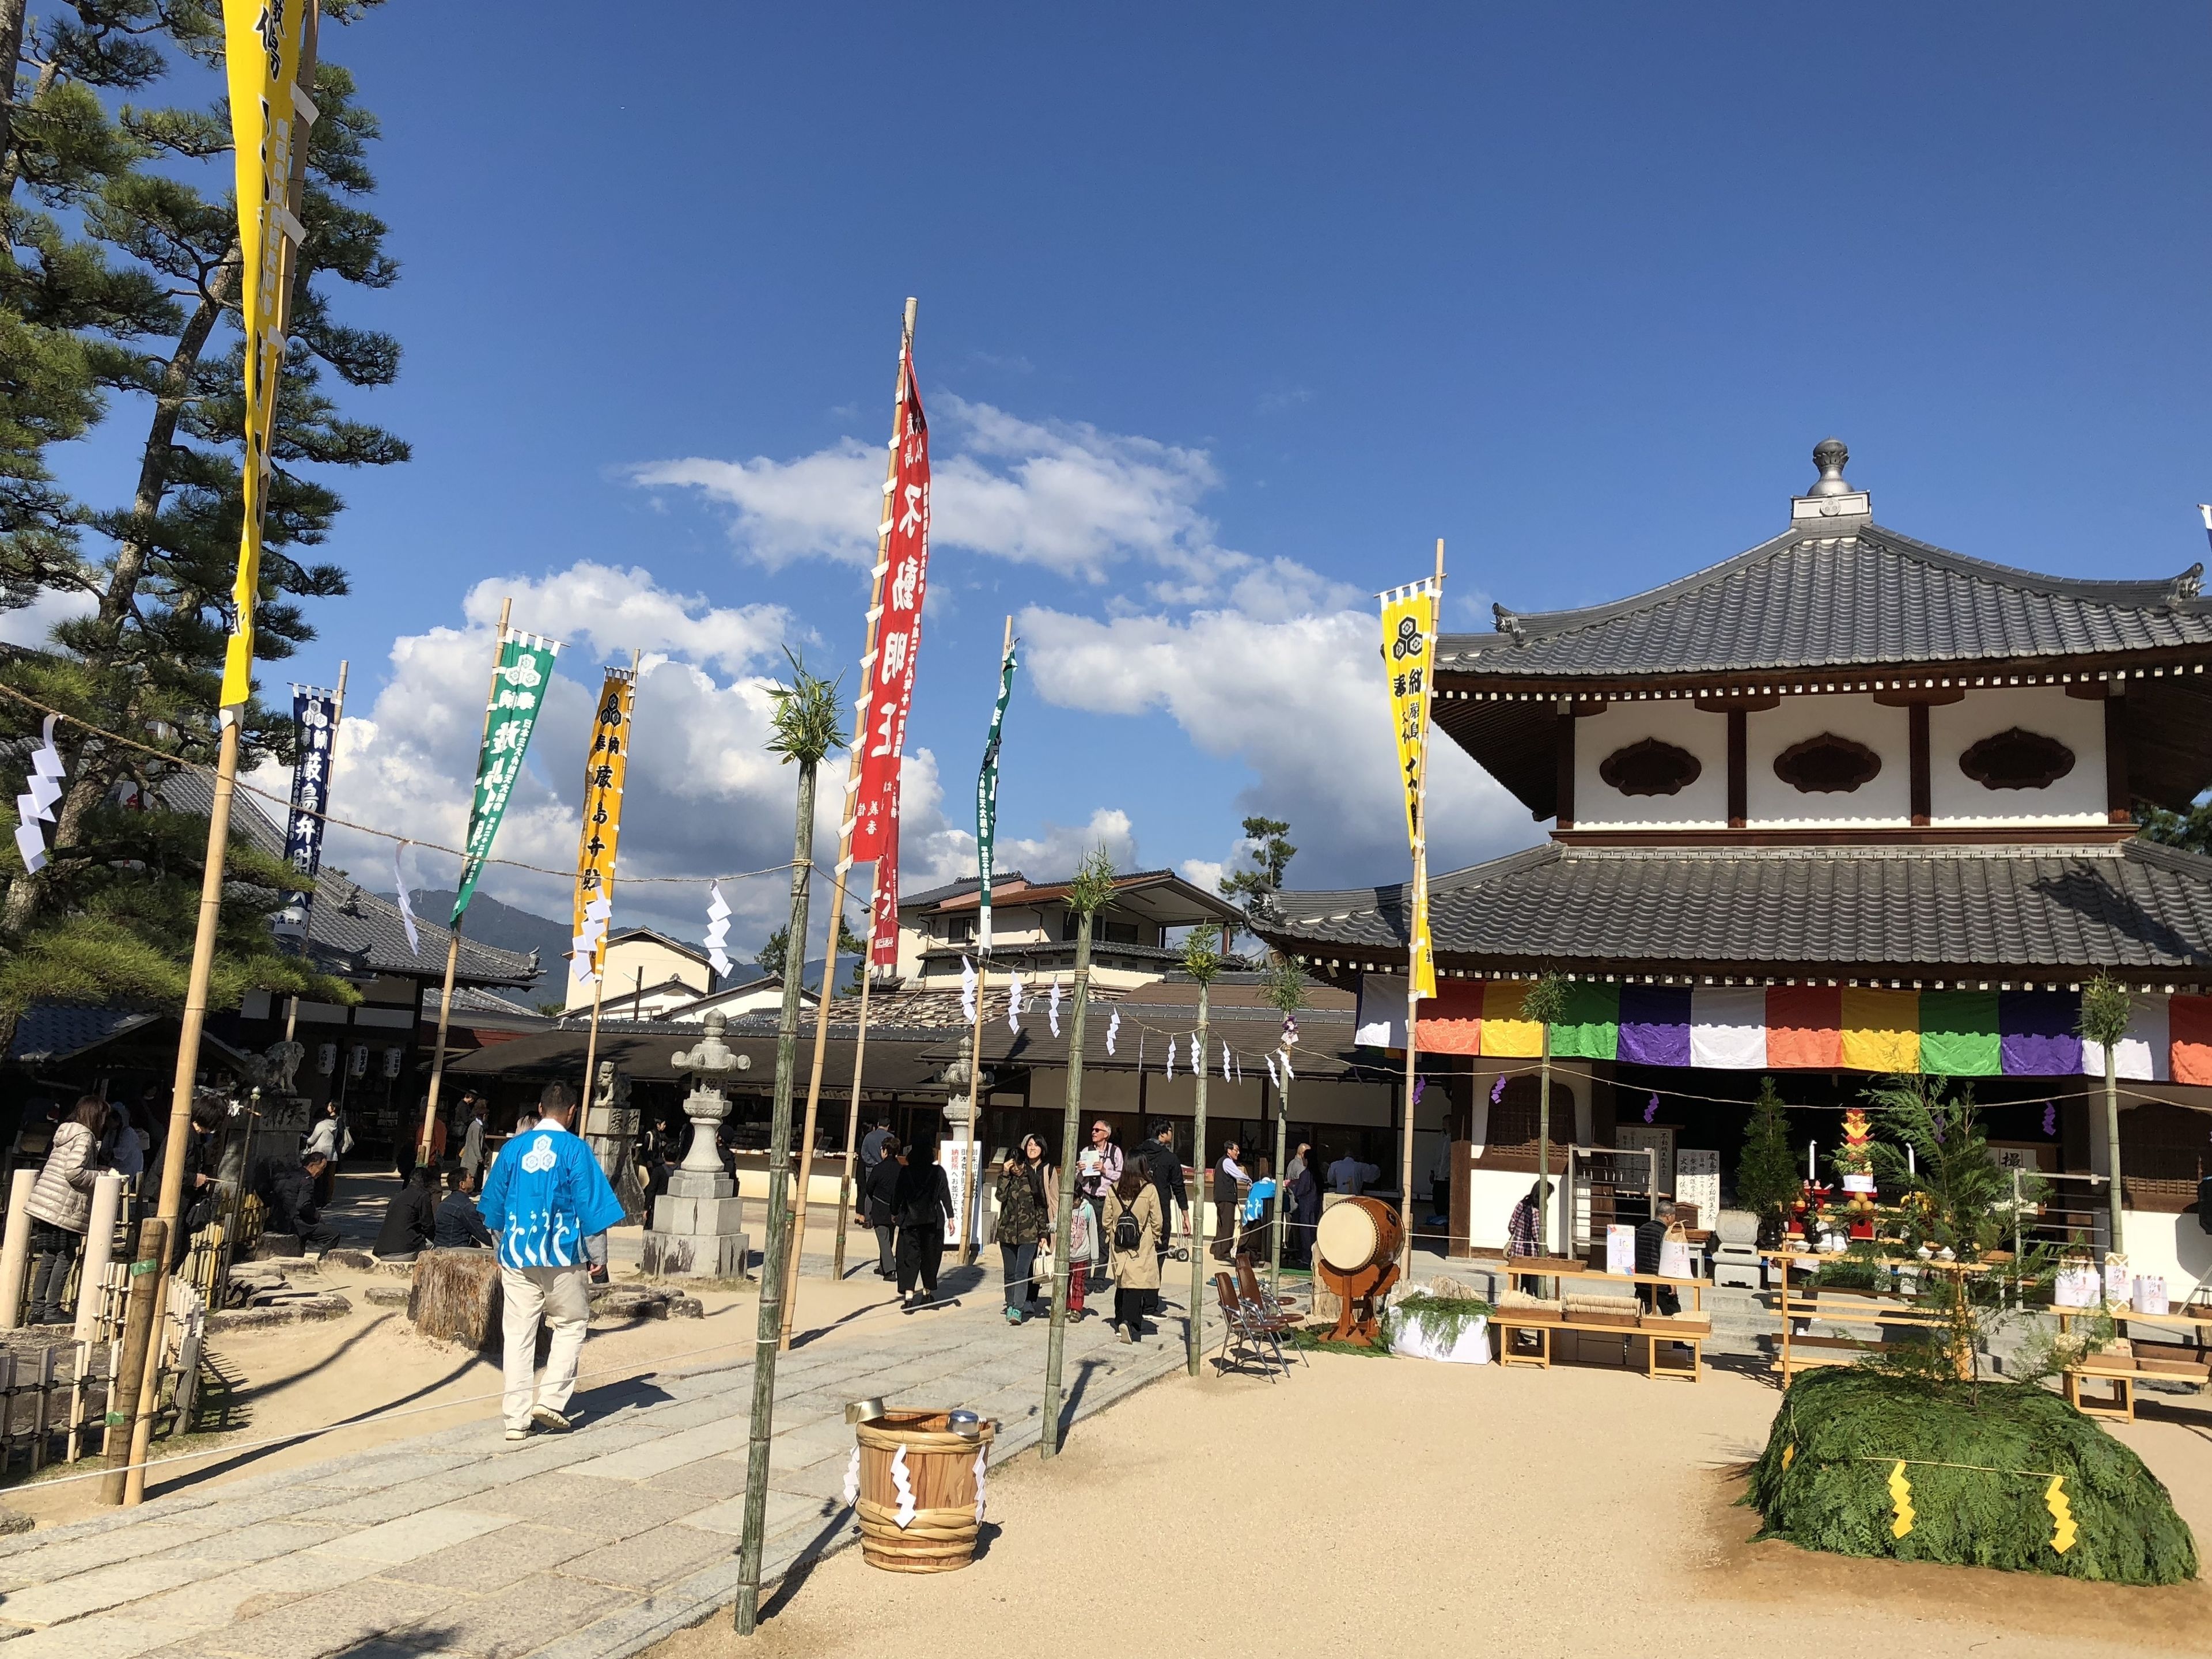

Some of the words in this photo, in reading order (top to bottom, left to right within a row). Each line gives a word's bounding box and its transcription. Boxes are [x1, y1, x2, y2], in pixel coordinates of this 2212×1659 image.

[594, 733, 620, 755] 奉納
[582, 765, 613, 923] 厳島弁財
